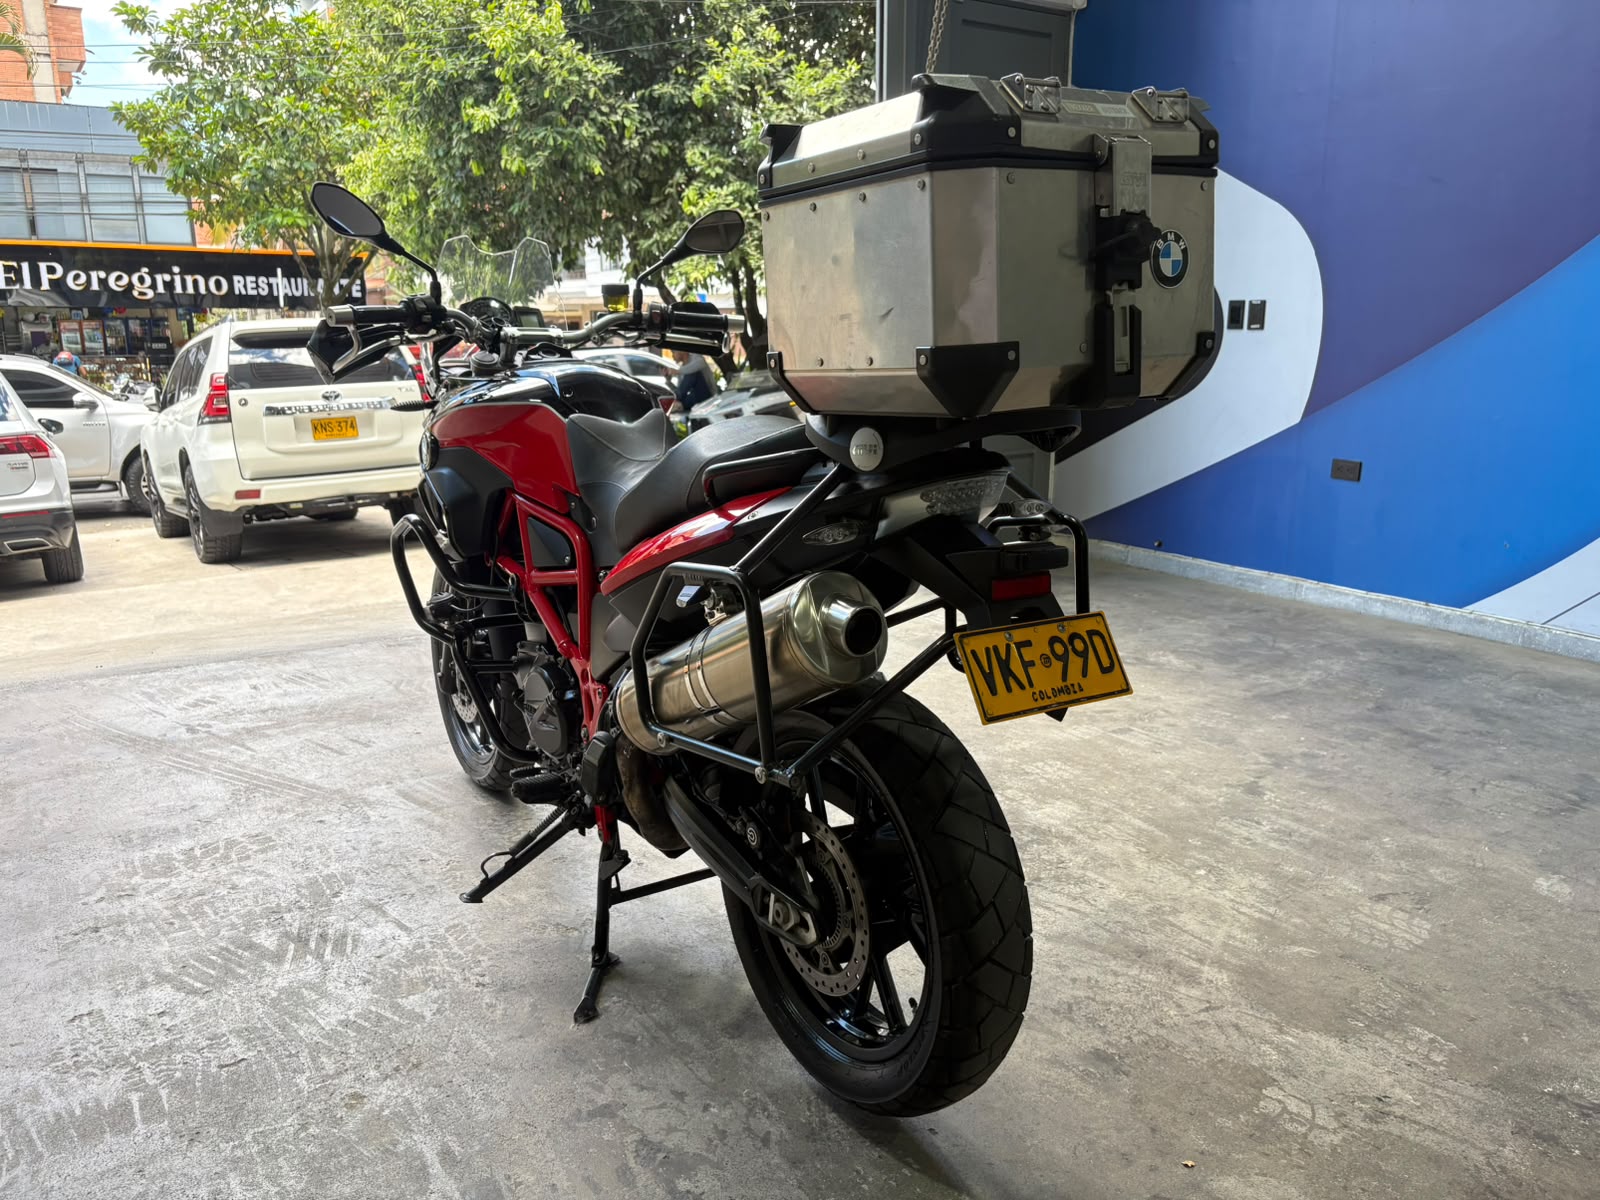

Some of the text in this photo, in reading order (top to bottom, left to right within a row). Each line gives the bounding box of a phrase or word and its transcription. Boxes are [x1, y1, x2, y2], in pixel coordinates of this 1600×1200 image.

[1156, 232, 1186, 250] BMW
[0, 260, 33, 290] El
[37, 261, 228, 300] Peregrino
[1031, 682, 1084, 702] COLOMBIA
